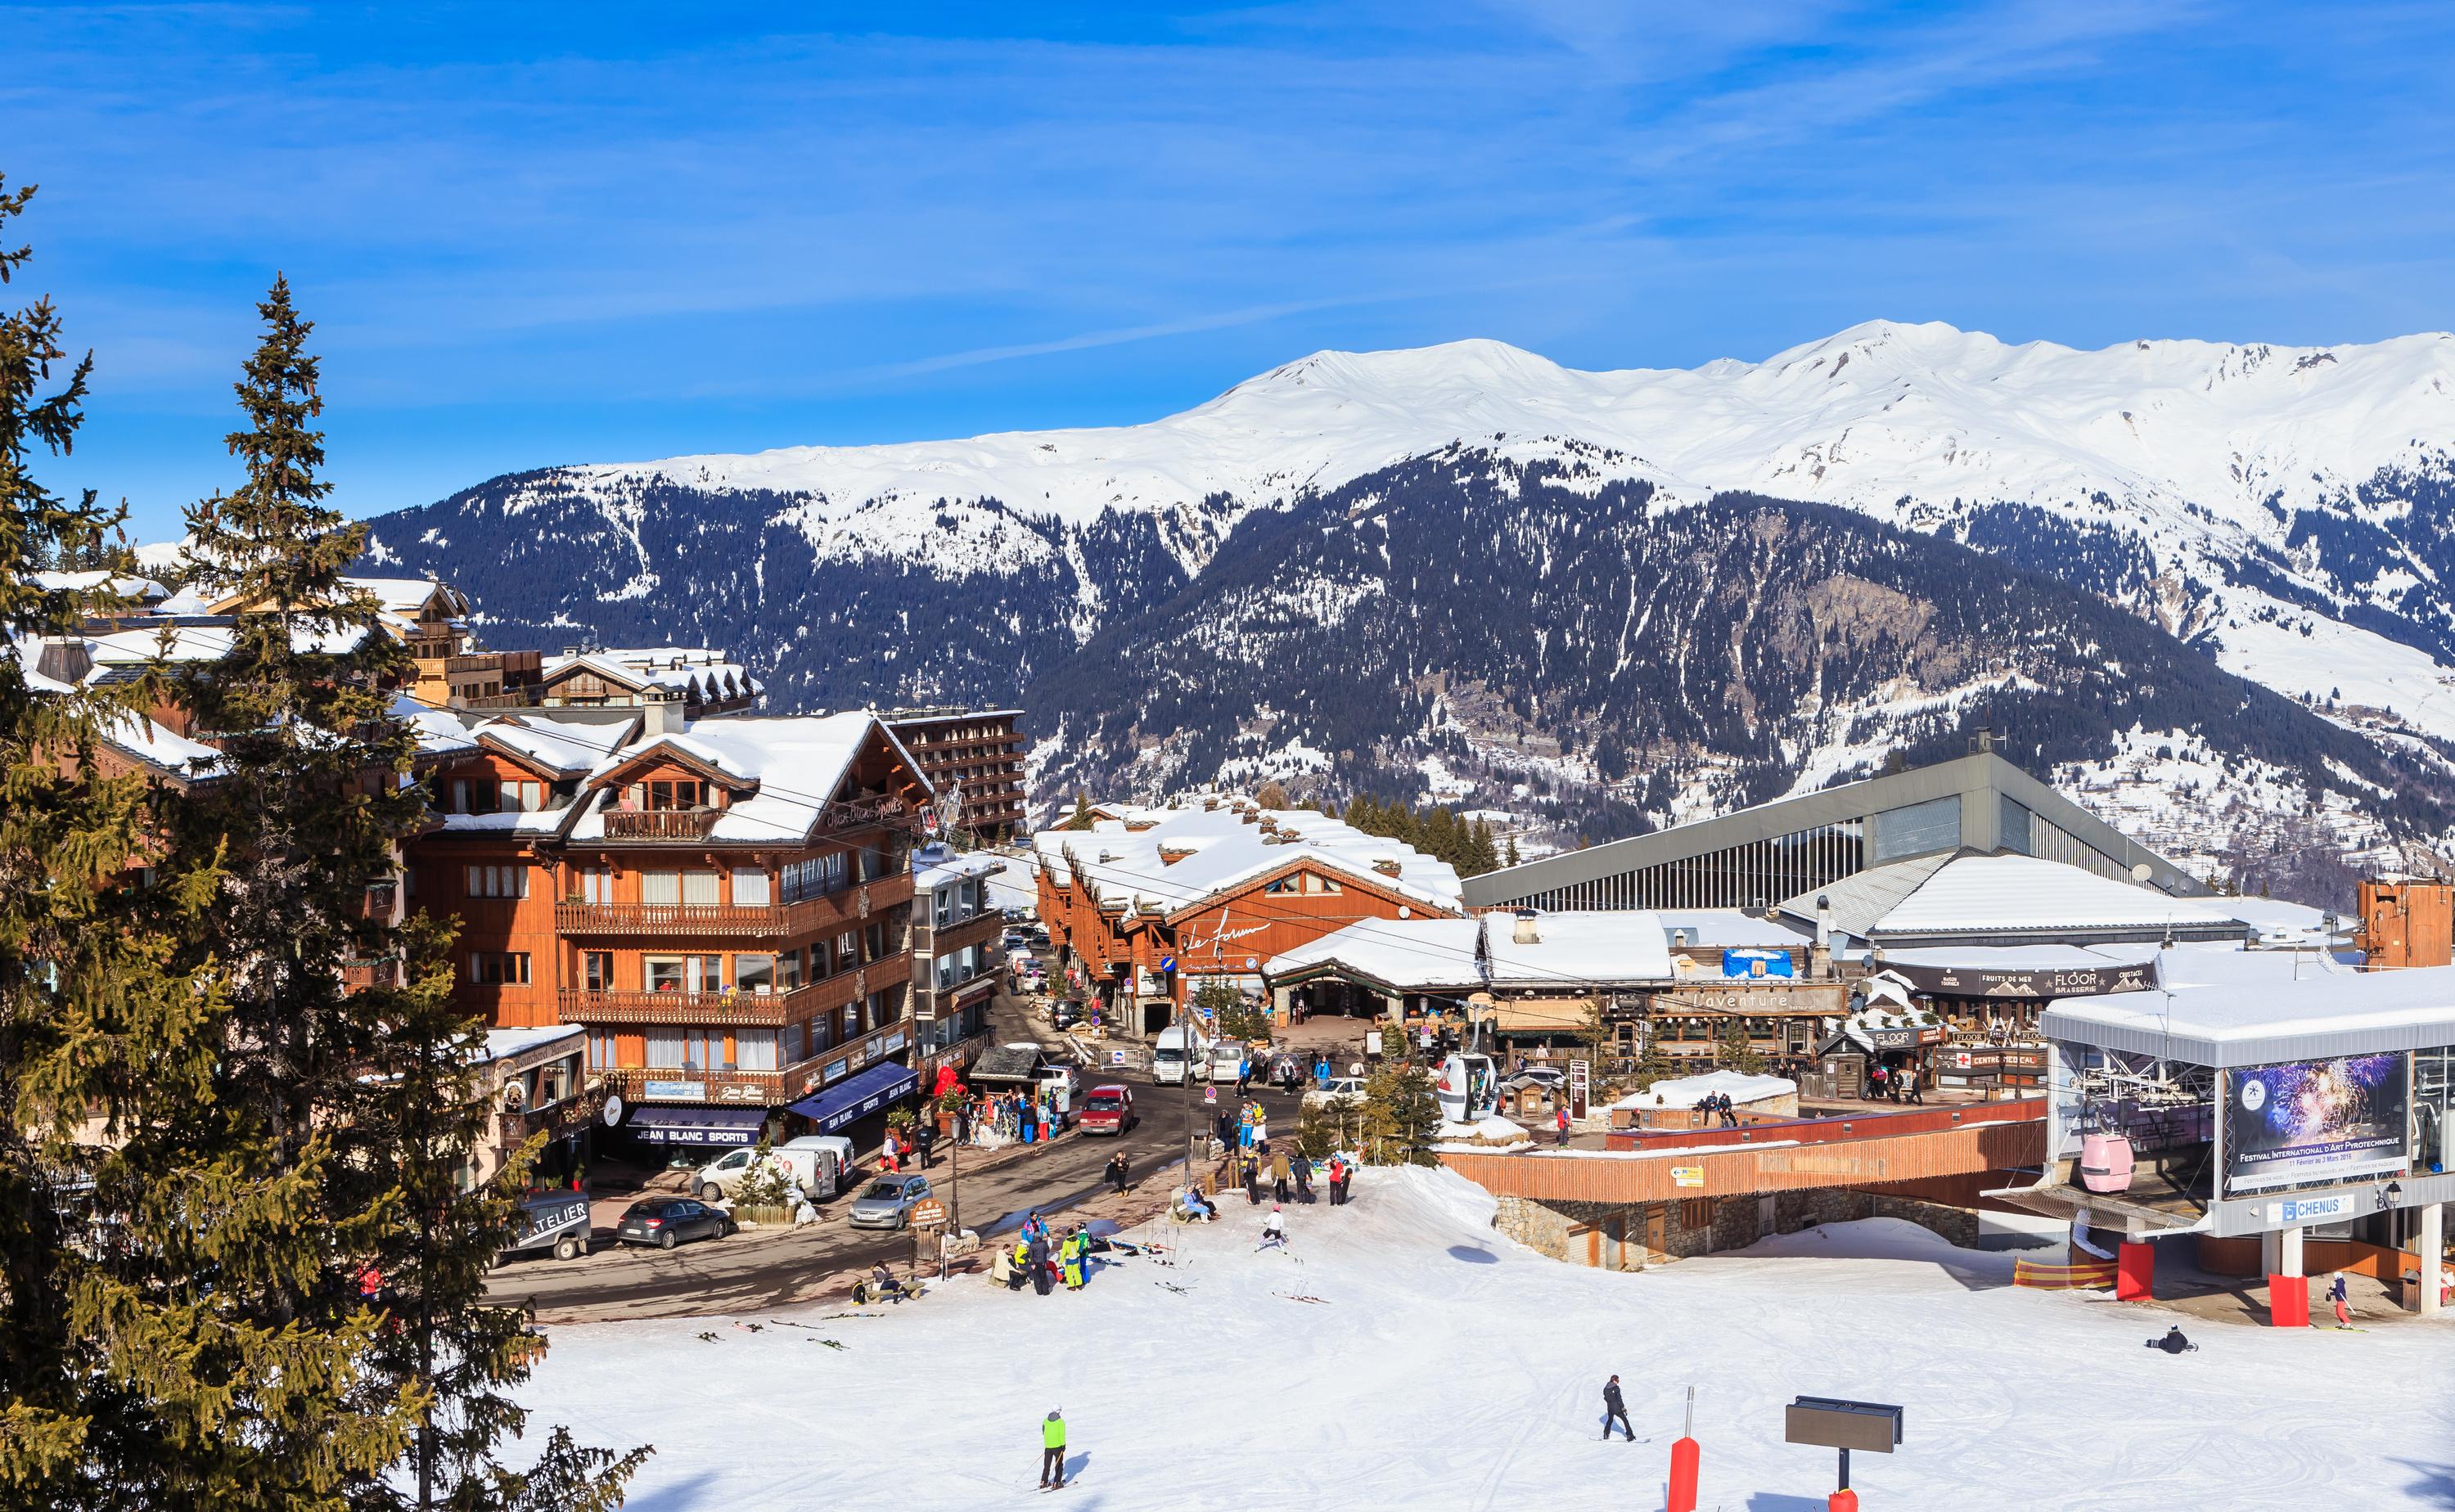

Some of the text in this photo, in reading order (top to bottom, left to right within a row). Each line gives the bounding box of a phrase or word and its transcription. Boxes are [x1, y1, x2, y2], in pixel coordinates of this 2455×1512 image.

[1187, 923, 1209, 951] Le
[2055, 973, 2097, 986] FLOOR
[1693, 993, 1787, 1007] L'aventure
[1876, 1032, 1909, 1042] FLOOR
[1974, 1056, 1999, 1064] CENTRE
[828, 1081, 912, 1129] JEAN BLANC SPORTS JEAN BLANC
[637, 1131, 749, 1142] JEAN BLANC SPORTS
[2298, 1199, 2340, 1216] CHENUS
